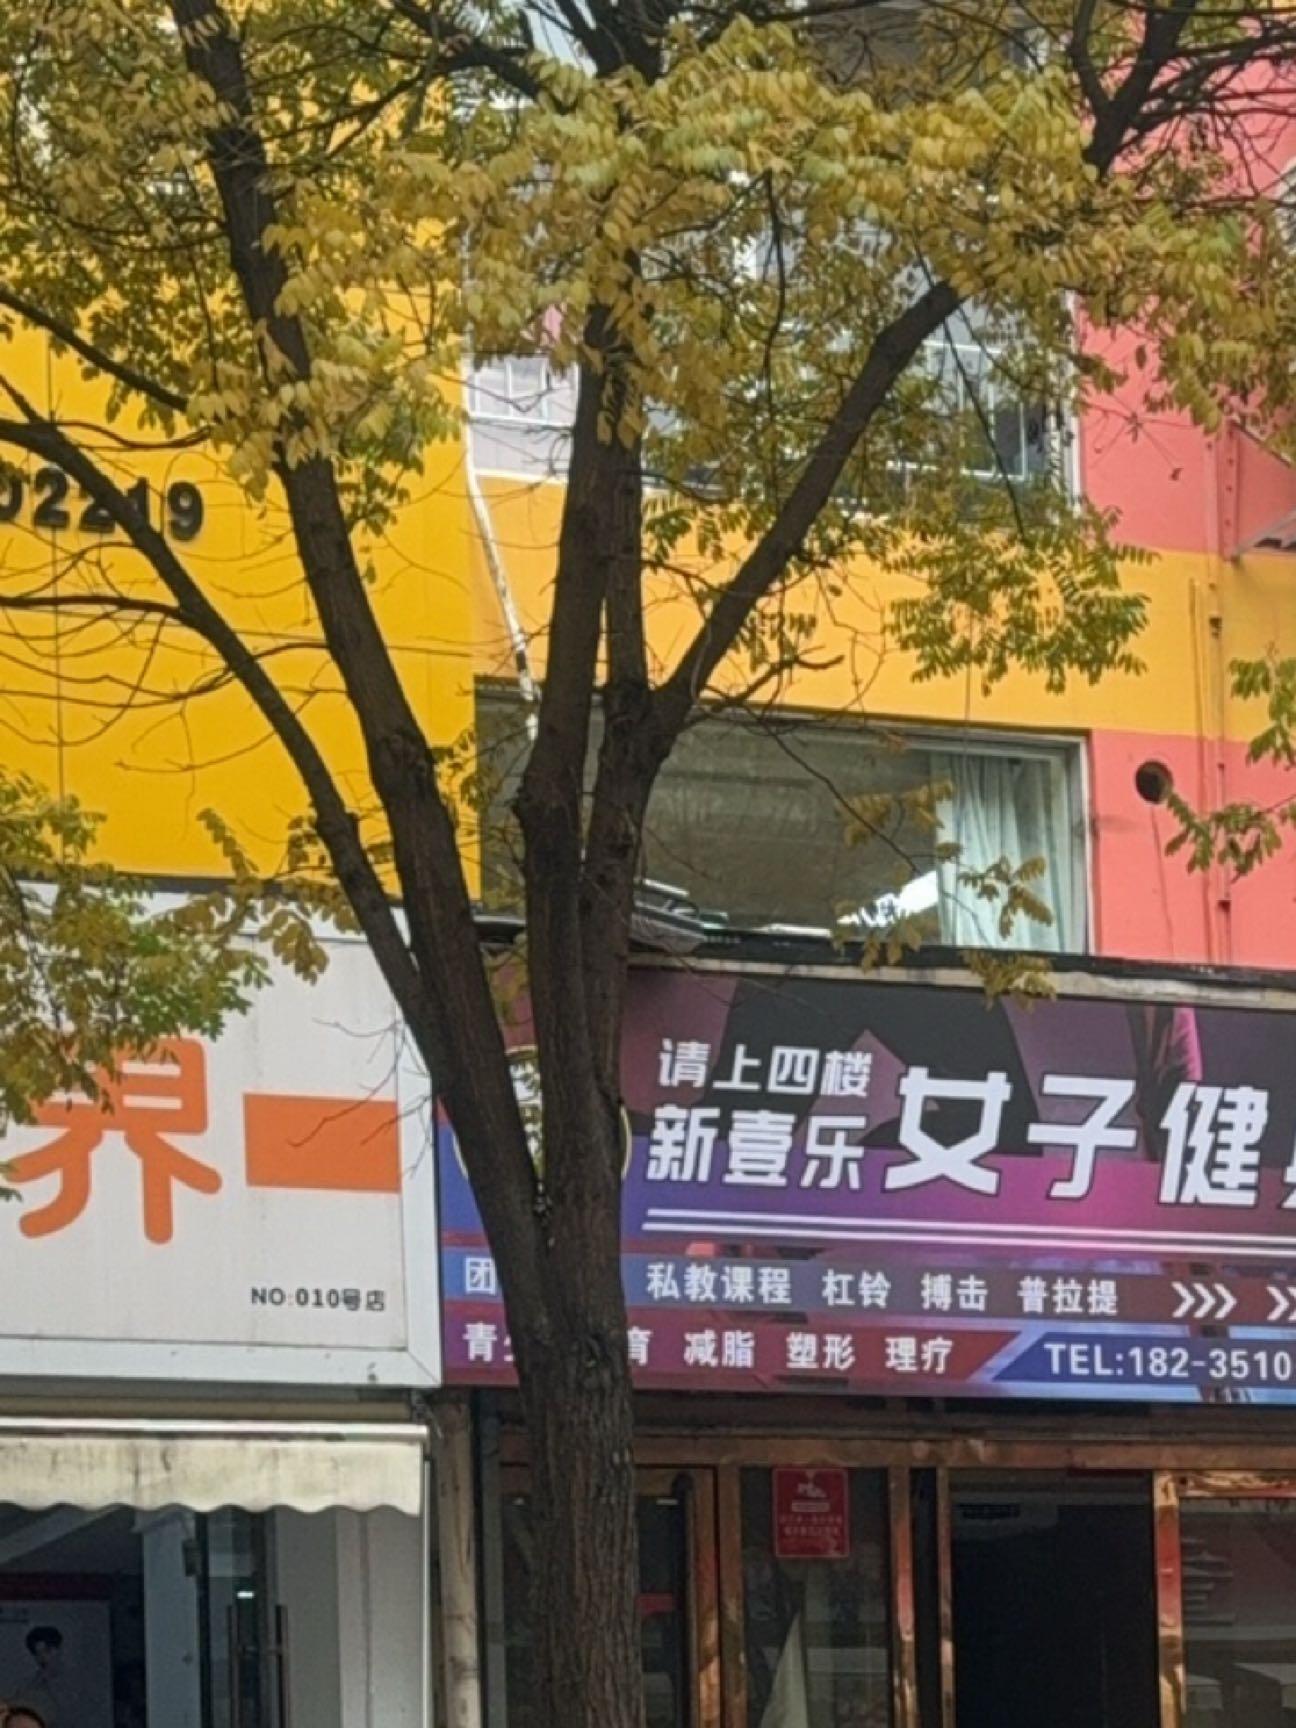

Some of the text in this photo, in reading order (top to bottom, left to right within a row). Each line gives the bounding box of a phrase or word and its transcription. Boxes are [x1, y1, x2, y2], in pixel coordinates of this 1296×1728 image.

[657, 1038, 874, 1099] 请上四楼
[646, 1104, 871, 1192] 新壹乐
[646, 1262, 793, 1306] 私教课程
[821, 1268, 892, 1308] 杠铃
[920, 1273, 988, 1313] 搏击
[1016, 1276, 1119, 1316] 普拉提
[683, 1328, 756, 1368] 减脂
[786, 1331, 856, 1370] 塑形
[885, 1336, 954, 1374] 理疗
